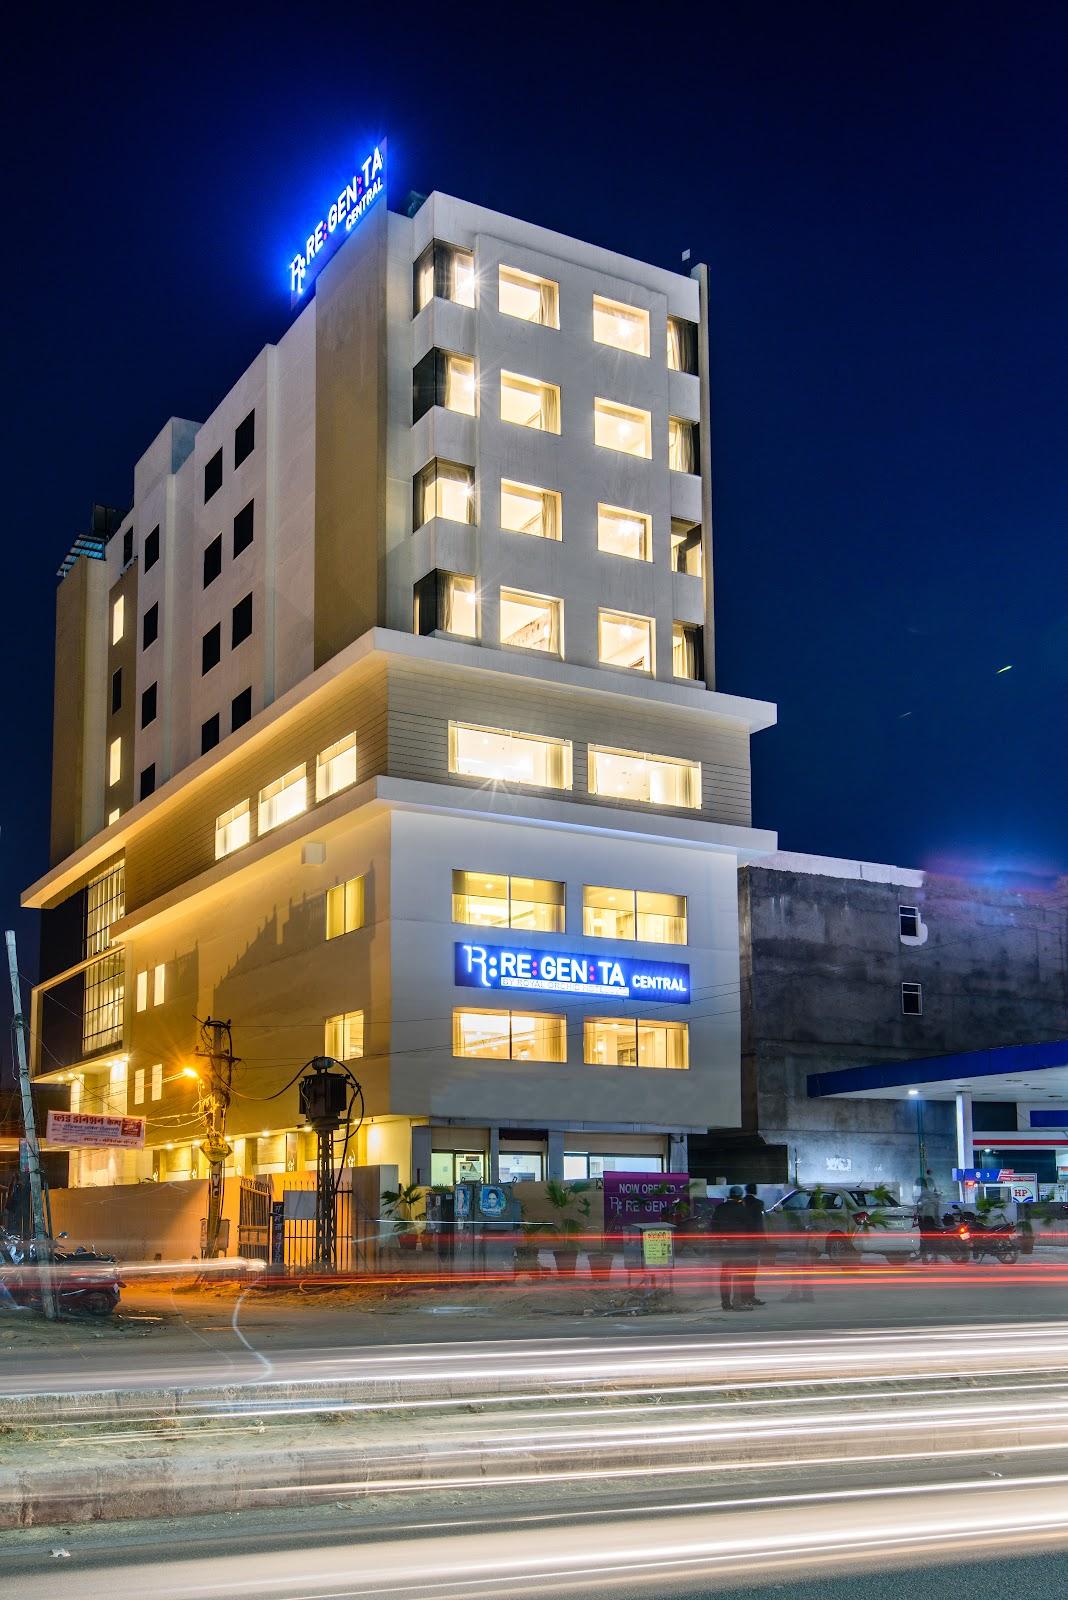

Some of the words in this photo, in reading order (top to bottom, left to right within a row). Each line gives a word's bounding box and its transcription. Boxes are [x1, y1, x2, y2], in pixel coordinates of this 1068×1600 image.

[345, 177, 384, 231] CENTRAL
[518, 979, 542, 989] ROYAL
[632, 974, 687, 992] CENTRAL
[619, 1183, 640, 1194] NOW
[641, 1183, 676, 1194] OPED
[1014, 1189, 1029, 1197] HP
